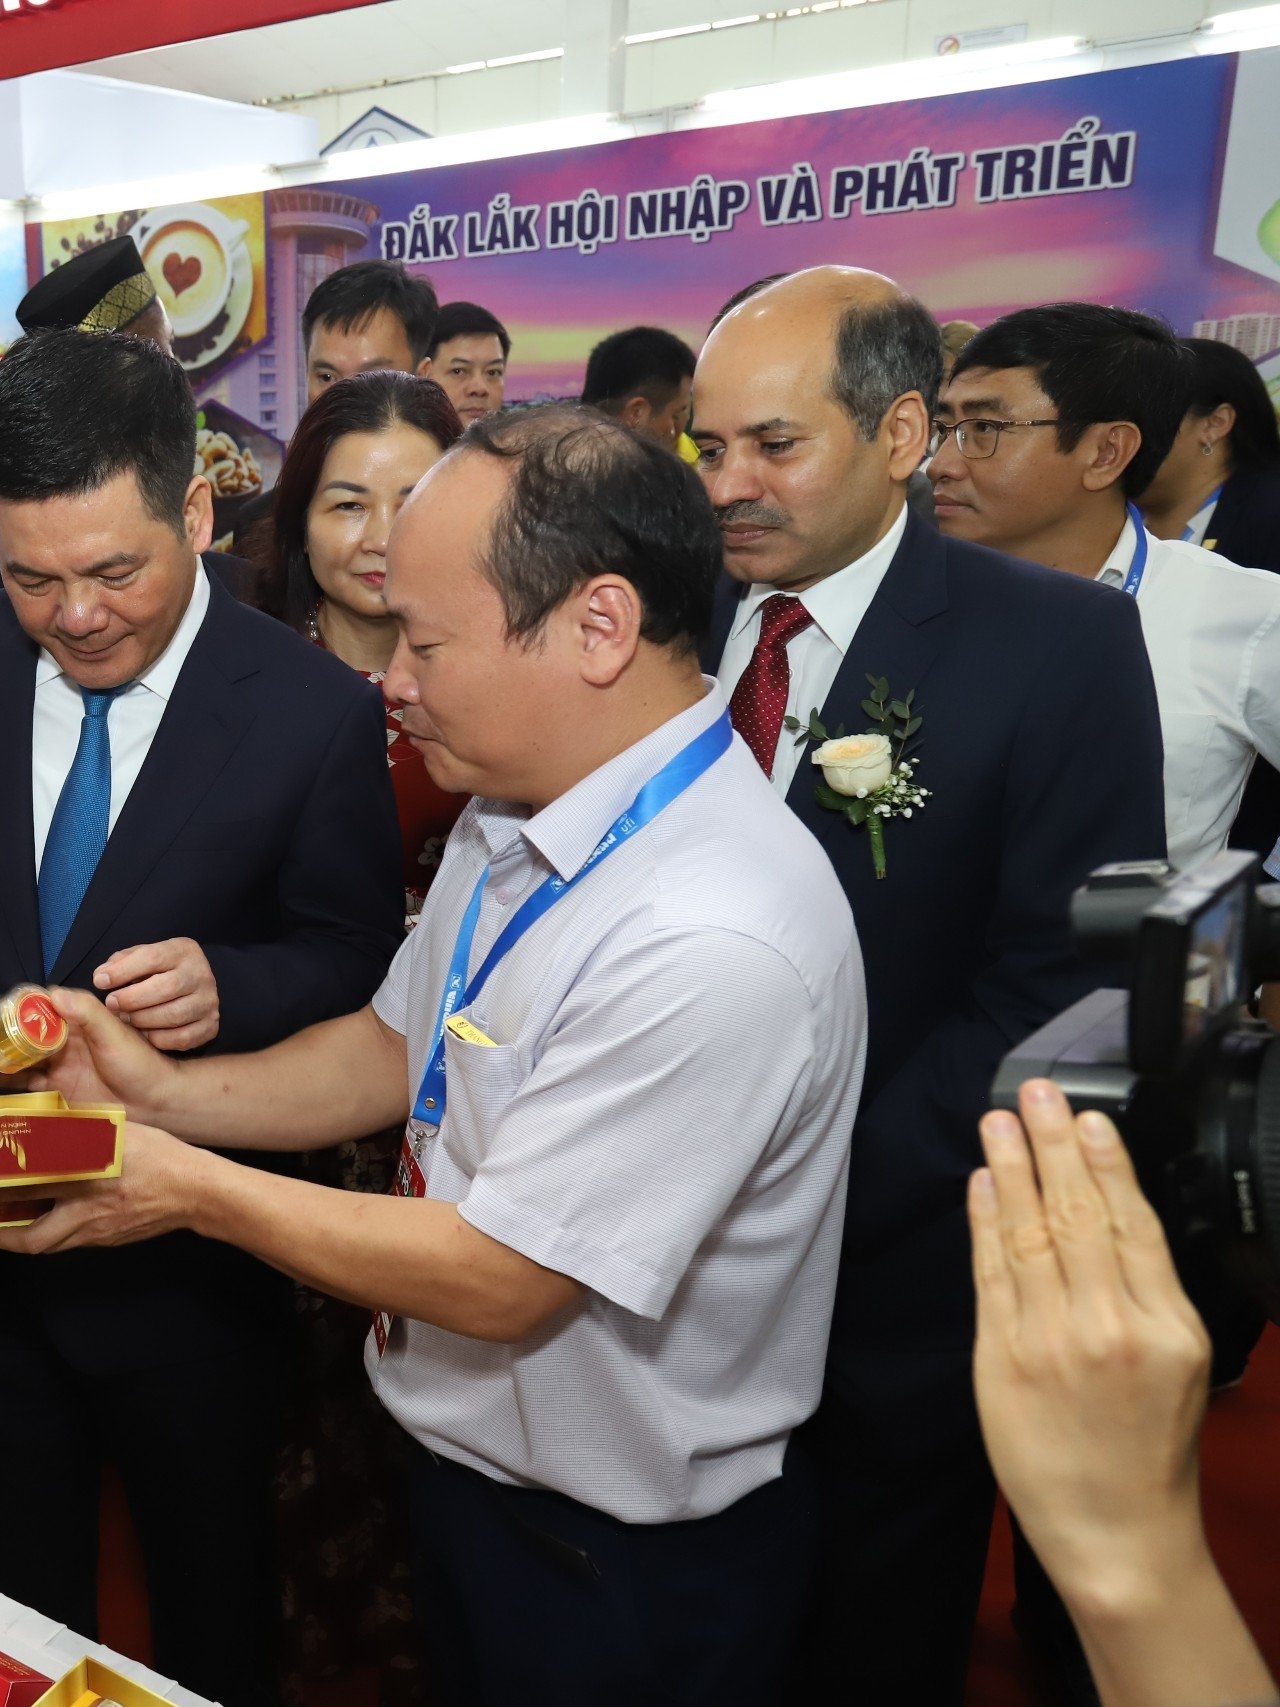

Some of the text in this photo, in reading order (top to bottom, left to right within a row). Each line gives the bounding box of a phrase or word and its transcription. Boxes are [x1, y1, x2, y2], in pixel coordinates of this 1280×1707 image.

[382, 118, 1135, 262] ĐẮK LẮK HỘI NHẬP VÀ PHÁT TRIỂN
